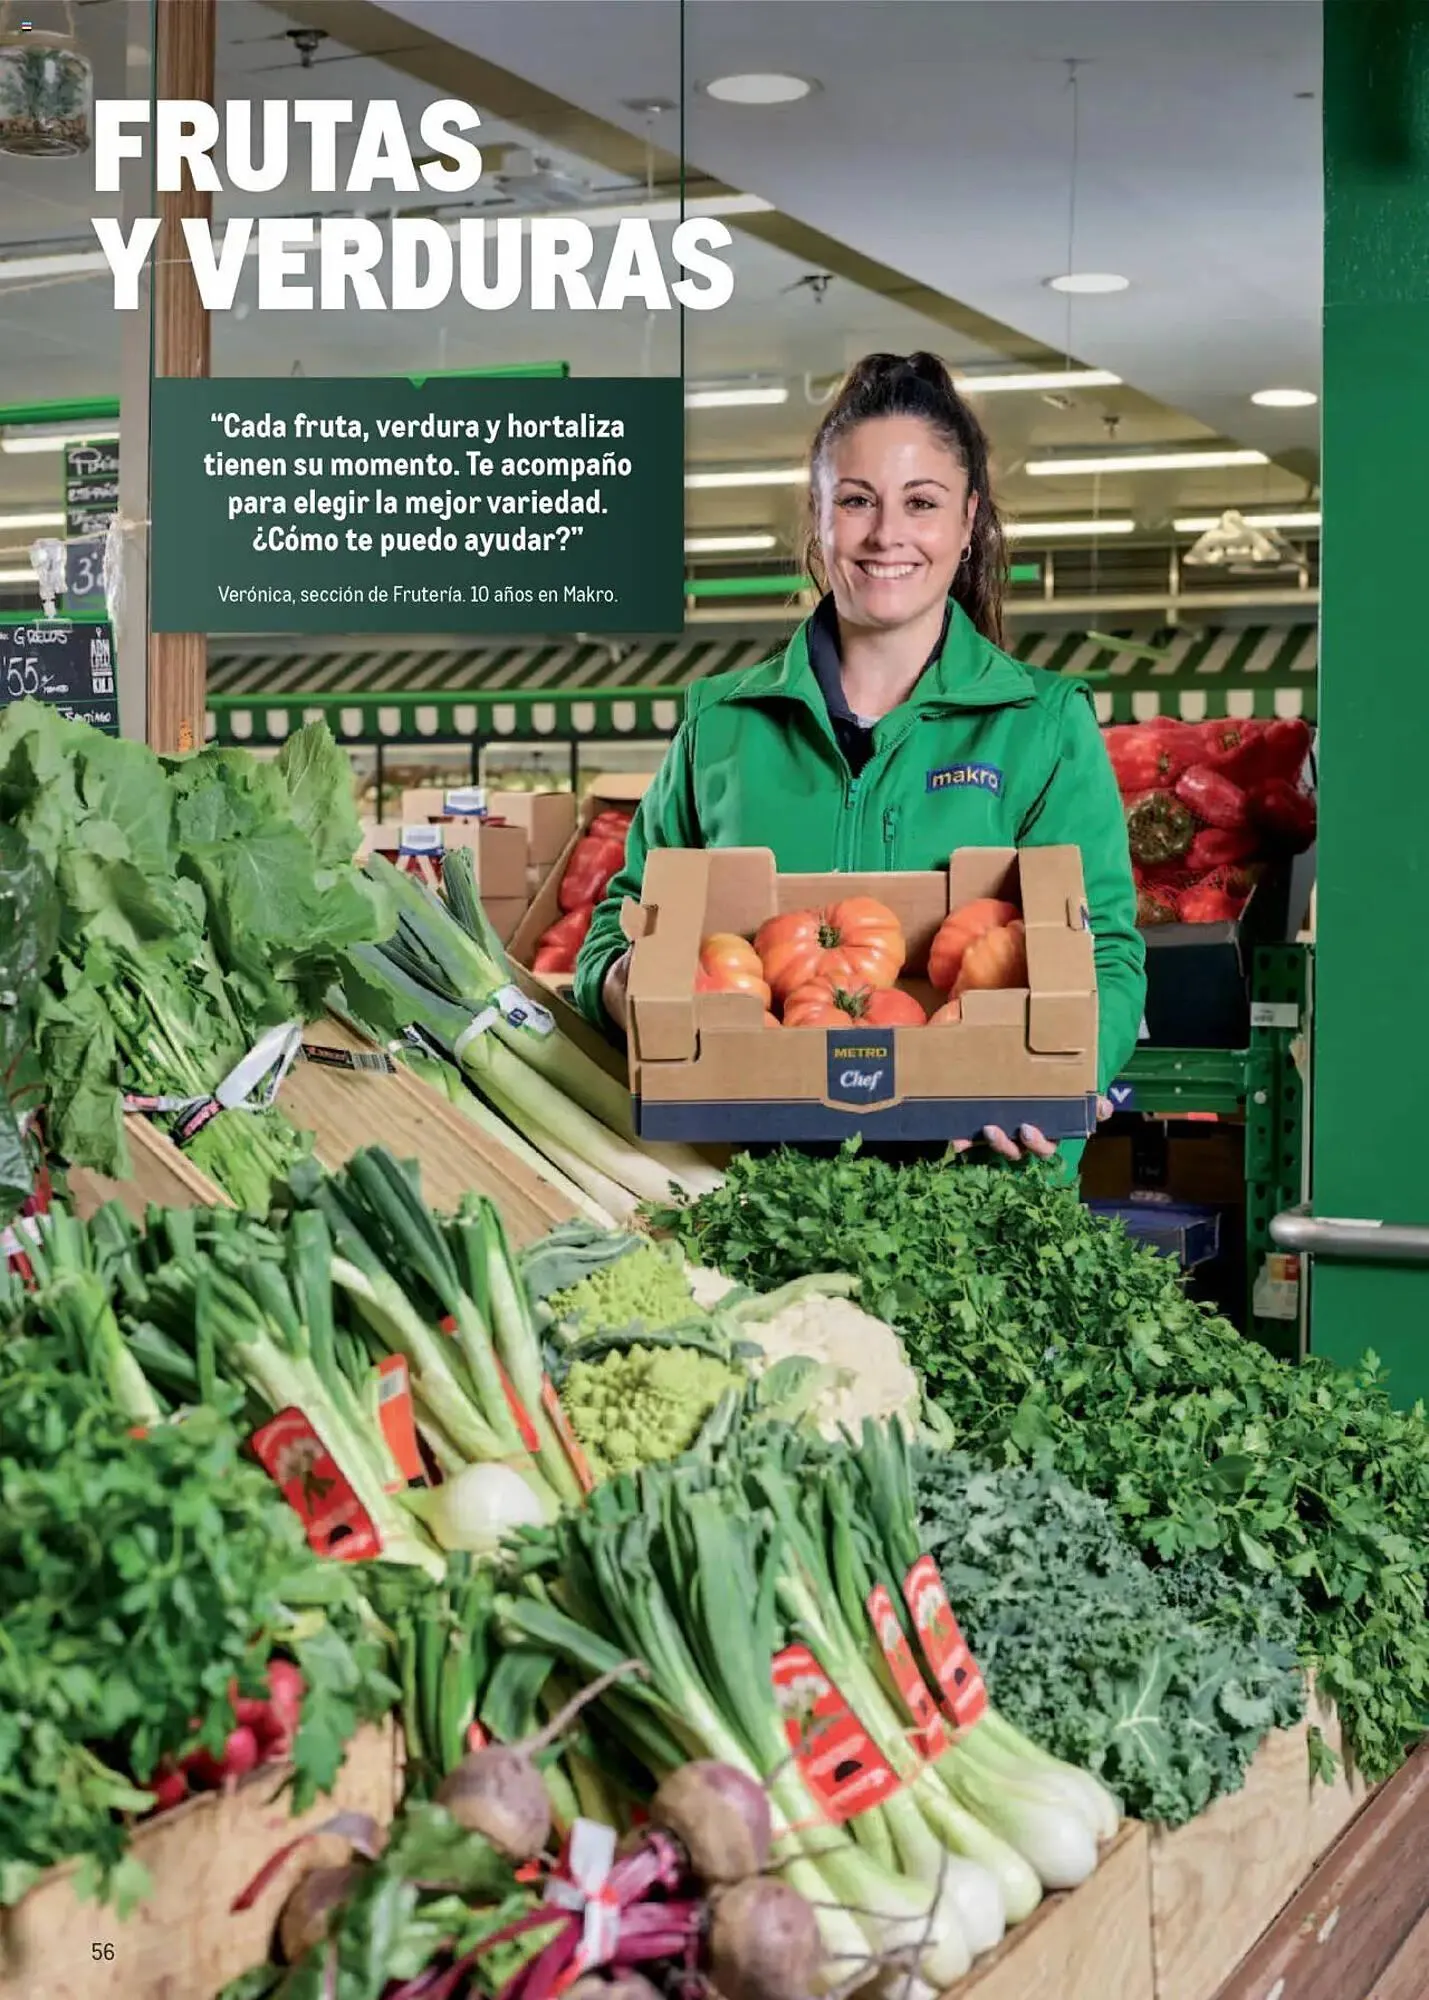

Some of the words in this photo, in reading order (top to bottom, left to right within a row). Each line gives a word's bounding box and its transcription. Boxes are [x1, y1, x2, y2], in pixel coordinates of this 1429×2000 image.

[932, 766, 998, 789] makro
[834, 1047, 888, 1058] METRO
[840, 1070, 883, 1091] Chef
